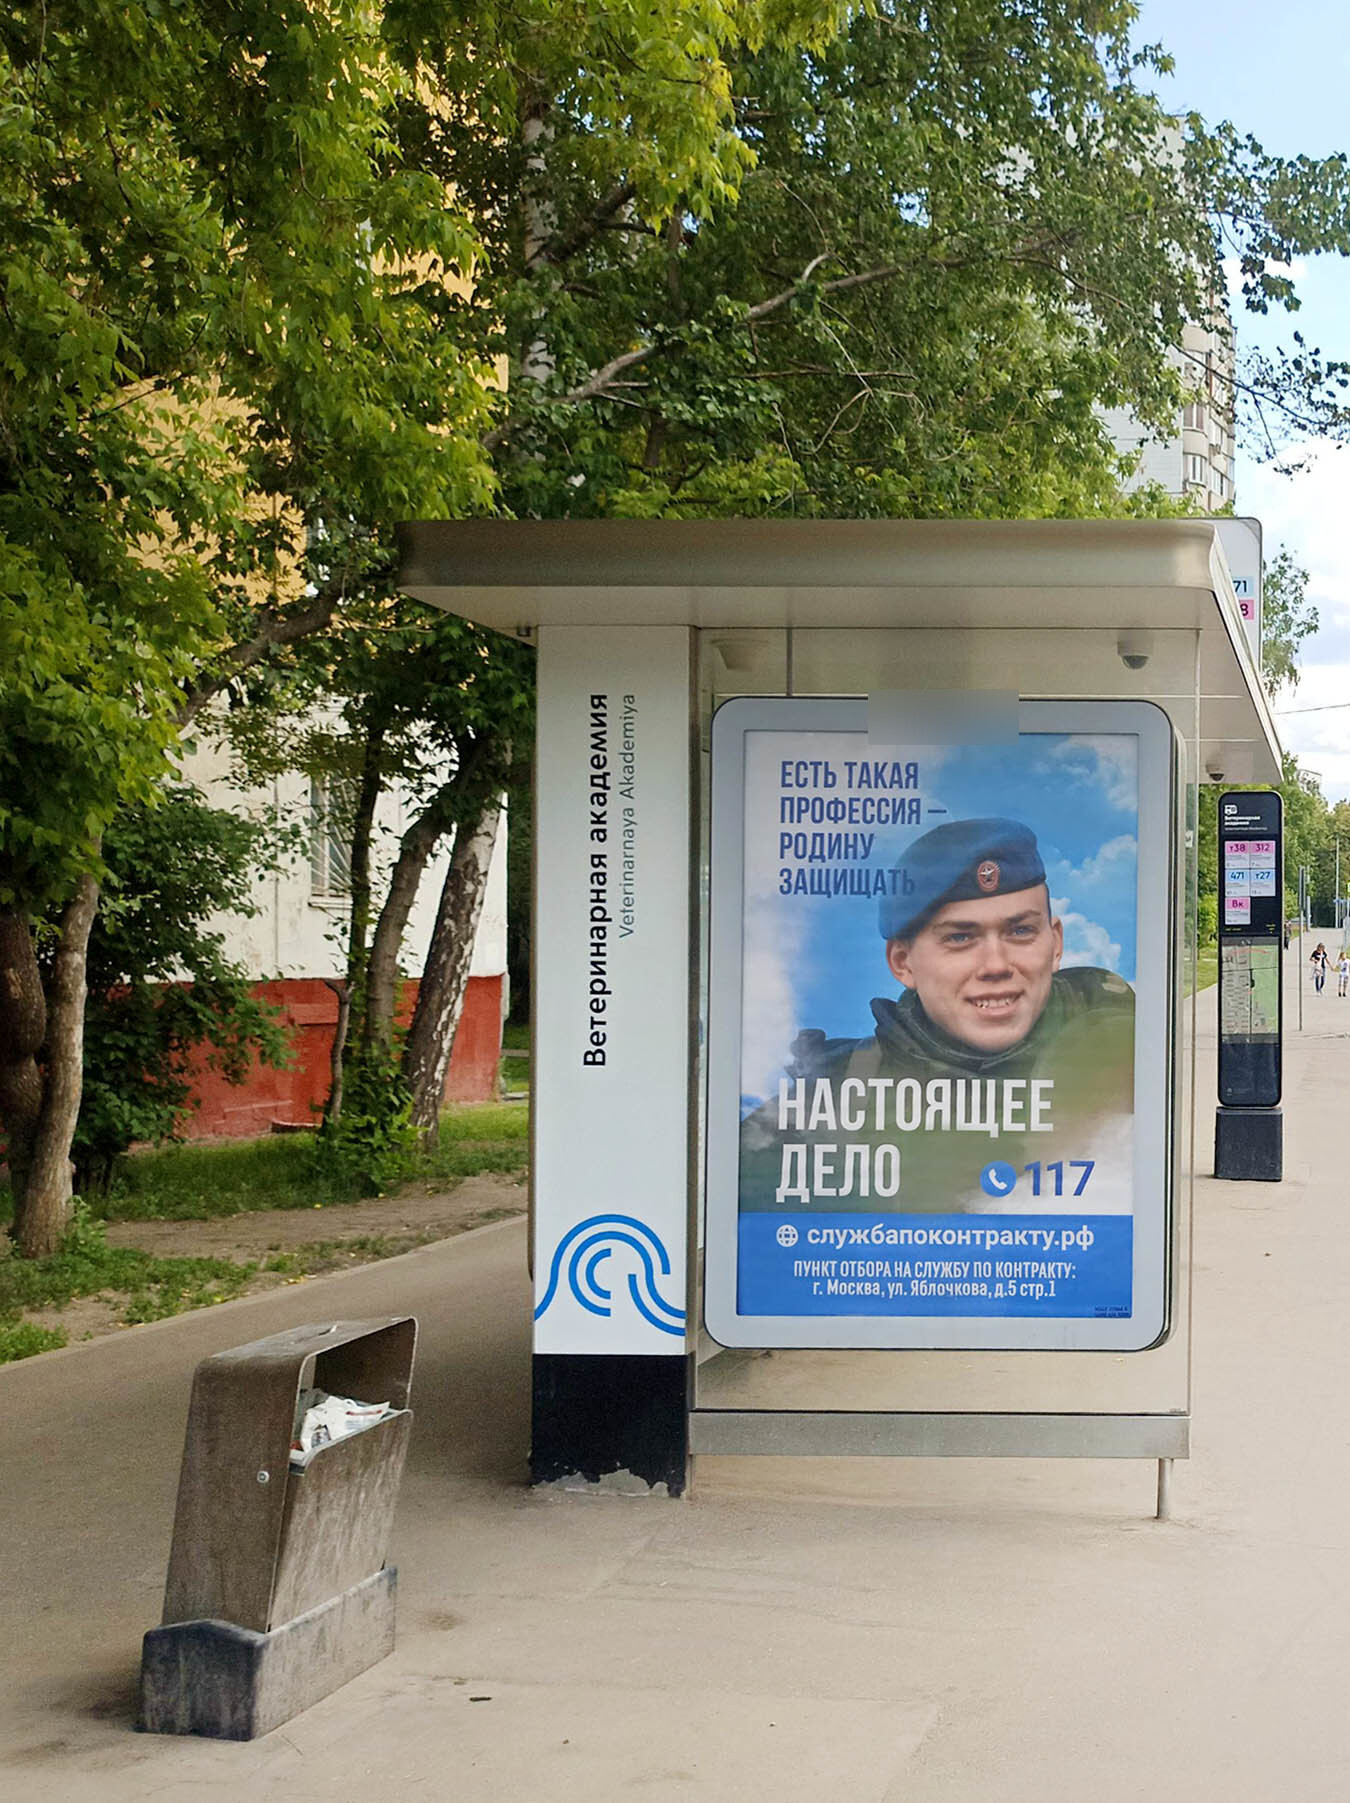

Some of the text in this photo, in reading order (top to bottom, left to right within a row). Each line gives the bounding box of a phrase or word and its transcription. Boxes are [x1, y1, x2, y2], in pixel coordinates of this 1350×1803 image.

[781, 760, 919, 789] ЕСТЬ ТАКАЯ
[618, 694, 641, 939] Veterinarnaya Akademiya
[780, 796, 921, 825] ПРОФЕССИЯ
[779, 832, 875, 863] РОДИНУ
[1255, 843, 1270, 852] 312
[584, 693, 611, 1067] Ветеринарная академия
[779, 868, 916, 899] ЗАЩИЩАТЬ
[1230, 871, 1245, 880] 471
[778, 1077, 1054, 1138] НАСТОЯЩЕЕ
[776, 1143, 901, 1204] ДЕЛО
[1023, 1160, 1096, 1197] 117
[807, 1223, 1095, 1251] службапоконтракту.рф
[794, 1260, 1077, 1279] ПУНКТ ОТБОРА НА СЛУЖБУ ПО КОНТРАКТУ:
[812, 1279, 1056, 1300] г. Москва, ул. Яблочкова, д.5 стр.1
